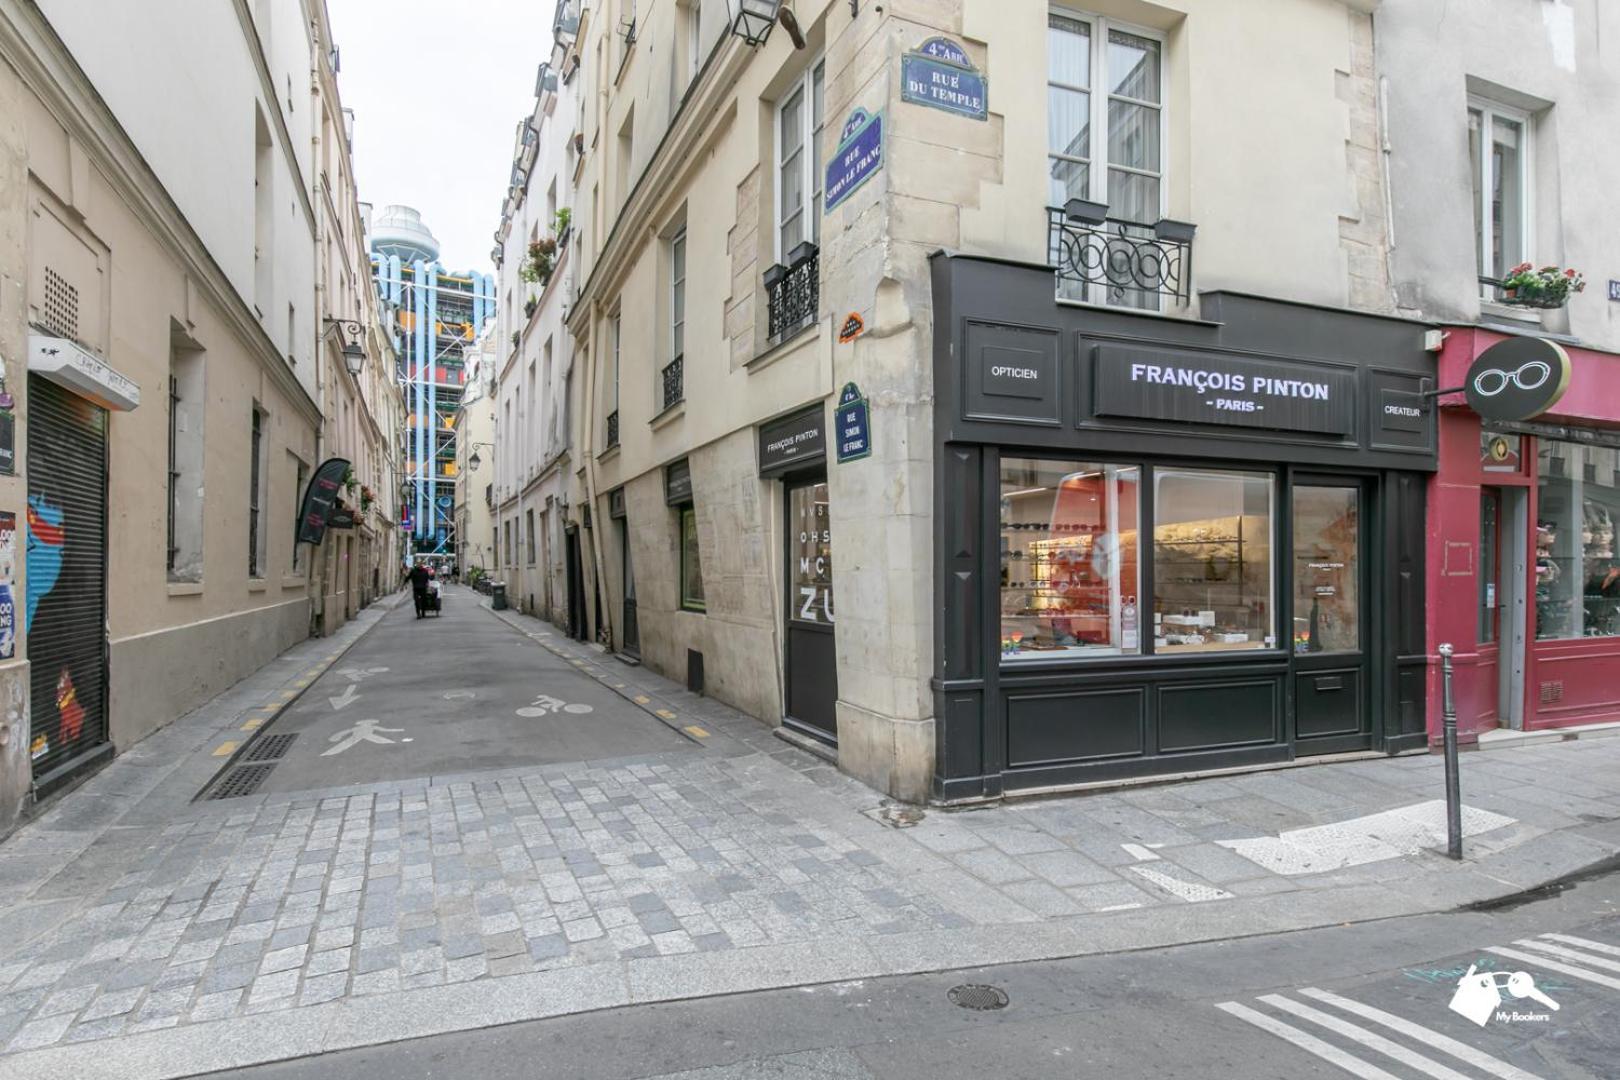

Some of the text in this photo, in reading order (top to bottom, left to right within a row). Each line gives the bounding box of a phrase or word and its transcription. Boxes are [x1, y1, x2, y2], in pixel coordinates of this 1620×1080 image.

[932, 72, 959, 88] RUE
[910, 81, 981, 108] DU TEMPLE
[844, 145, 860, 167] RUE
[856, 143, 881, 174] FRANC
[991, 366, 1038, 379] OPTICIEN
[1131, 363, 1329, 400] FRANÇOIS PINTON
